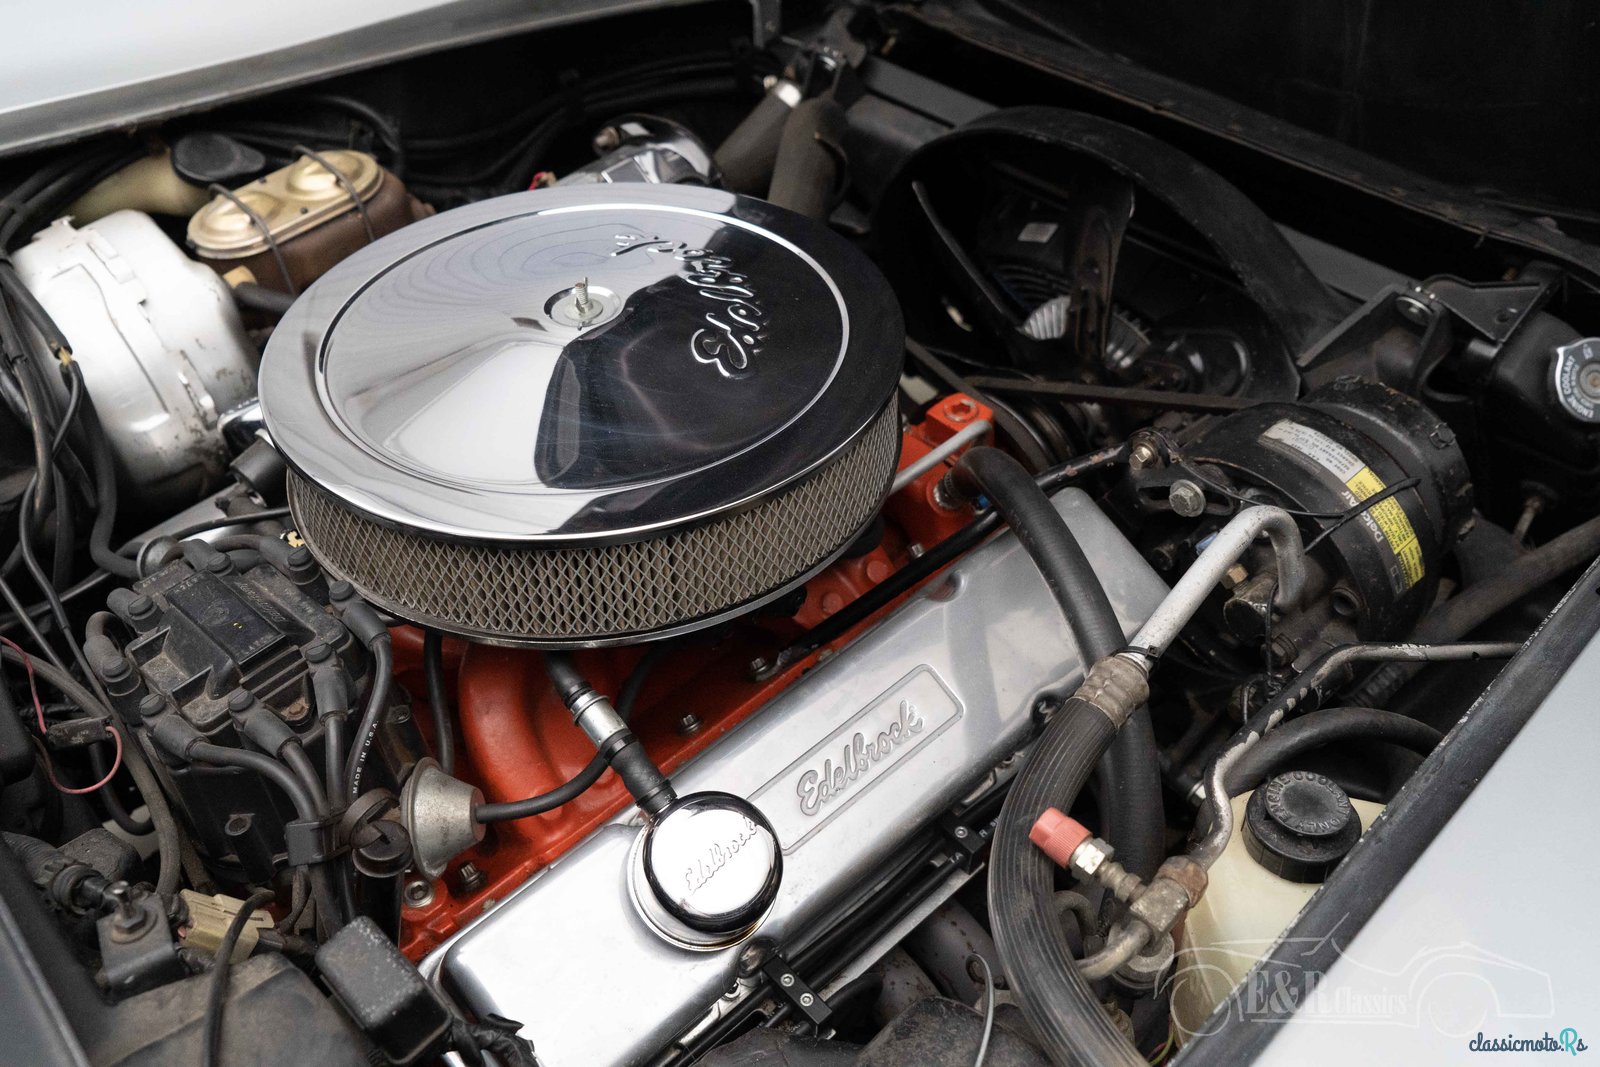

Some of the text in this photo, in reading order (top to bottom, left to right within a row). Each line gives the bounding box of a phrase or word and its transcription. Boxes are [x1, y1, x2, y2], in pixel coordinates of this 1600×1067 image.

[1562, 355, 1576, 394] COOLANT
[1341, 490, 1360, 507] Air
[352, 765, 363, 795] MADE
[365, 721, 379, 747] U.S.A.
[796, 699, 925, 817] Edelbrock
[1267, 771, 1351, 832] ENGINE COOLANT ONLY
[684, 815, 758, 895] Edelbrock
